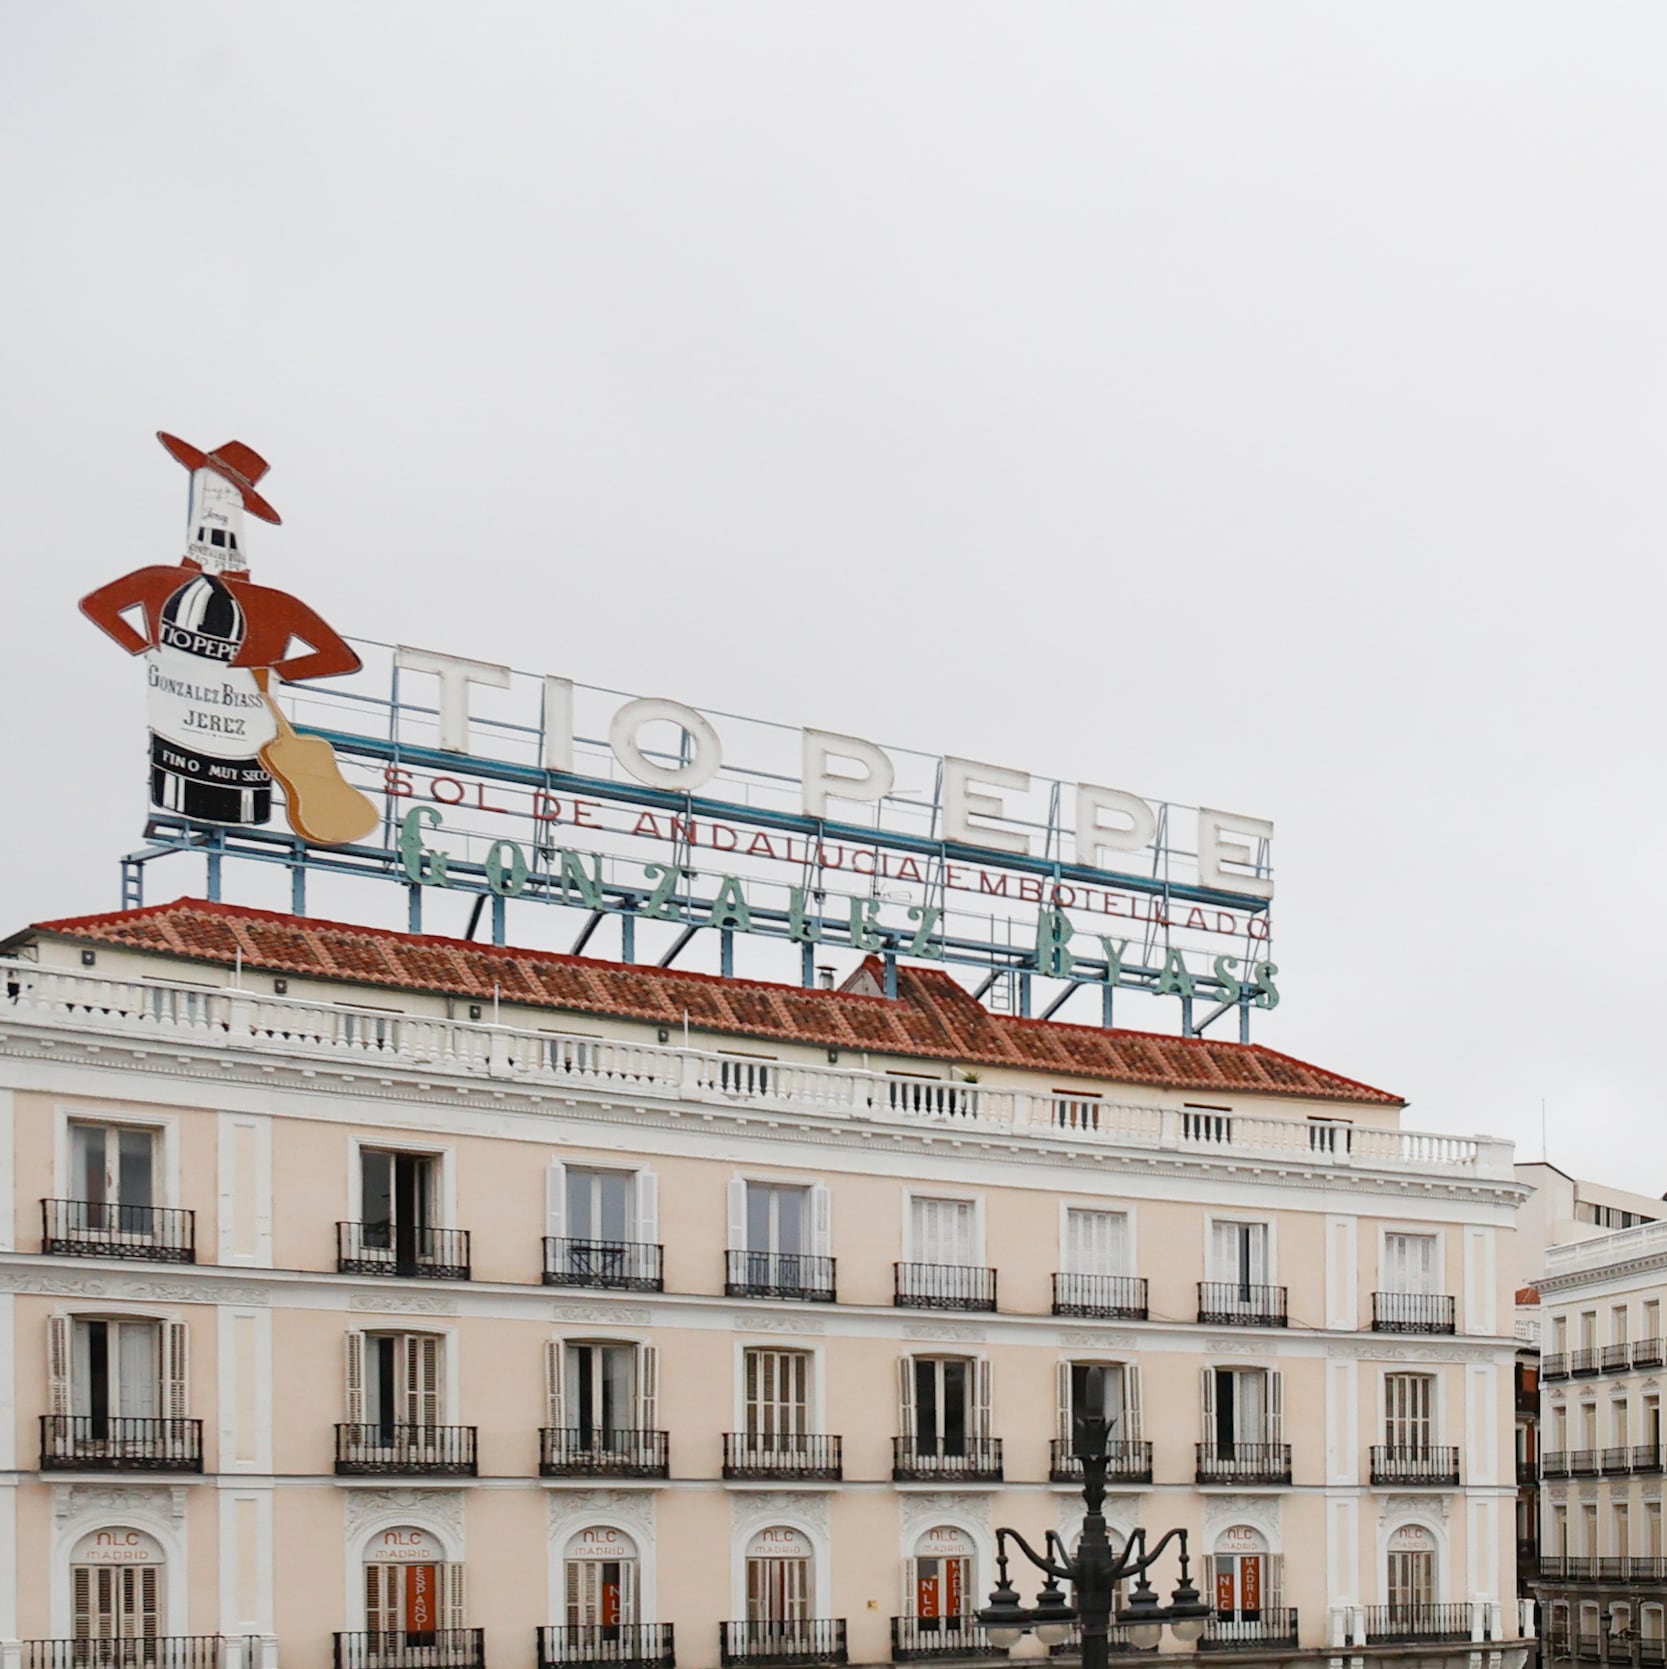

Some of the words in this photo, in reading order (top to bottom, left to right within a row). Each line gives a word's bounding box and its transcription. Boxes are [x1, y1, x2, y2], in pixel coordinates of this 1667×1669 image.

[160, 625, 191, 648] TIO
[193, 638, 240, 661] PEPE
[162, 750, 201, 772] FINO
[242, 769, 271, 783] SECO
[183, 709, 247, 736] JEREZ
[395, 643, 722, 792] TIO
[803, 726, 1274, 901] PEPE
[384, 767, 507, 813] SOL
[533, 791, 602, 829] DE
[632, 811, 924, 884] ANDALUCIA
[945, 863, 1271, 940] EMBOTELLADO
[399, 805, 944, 960] GONZALEZ
[1037, 906, 1280, 1010] BYASS
